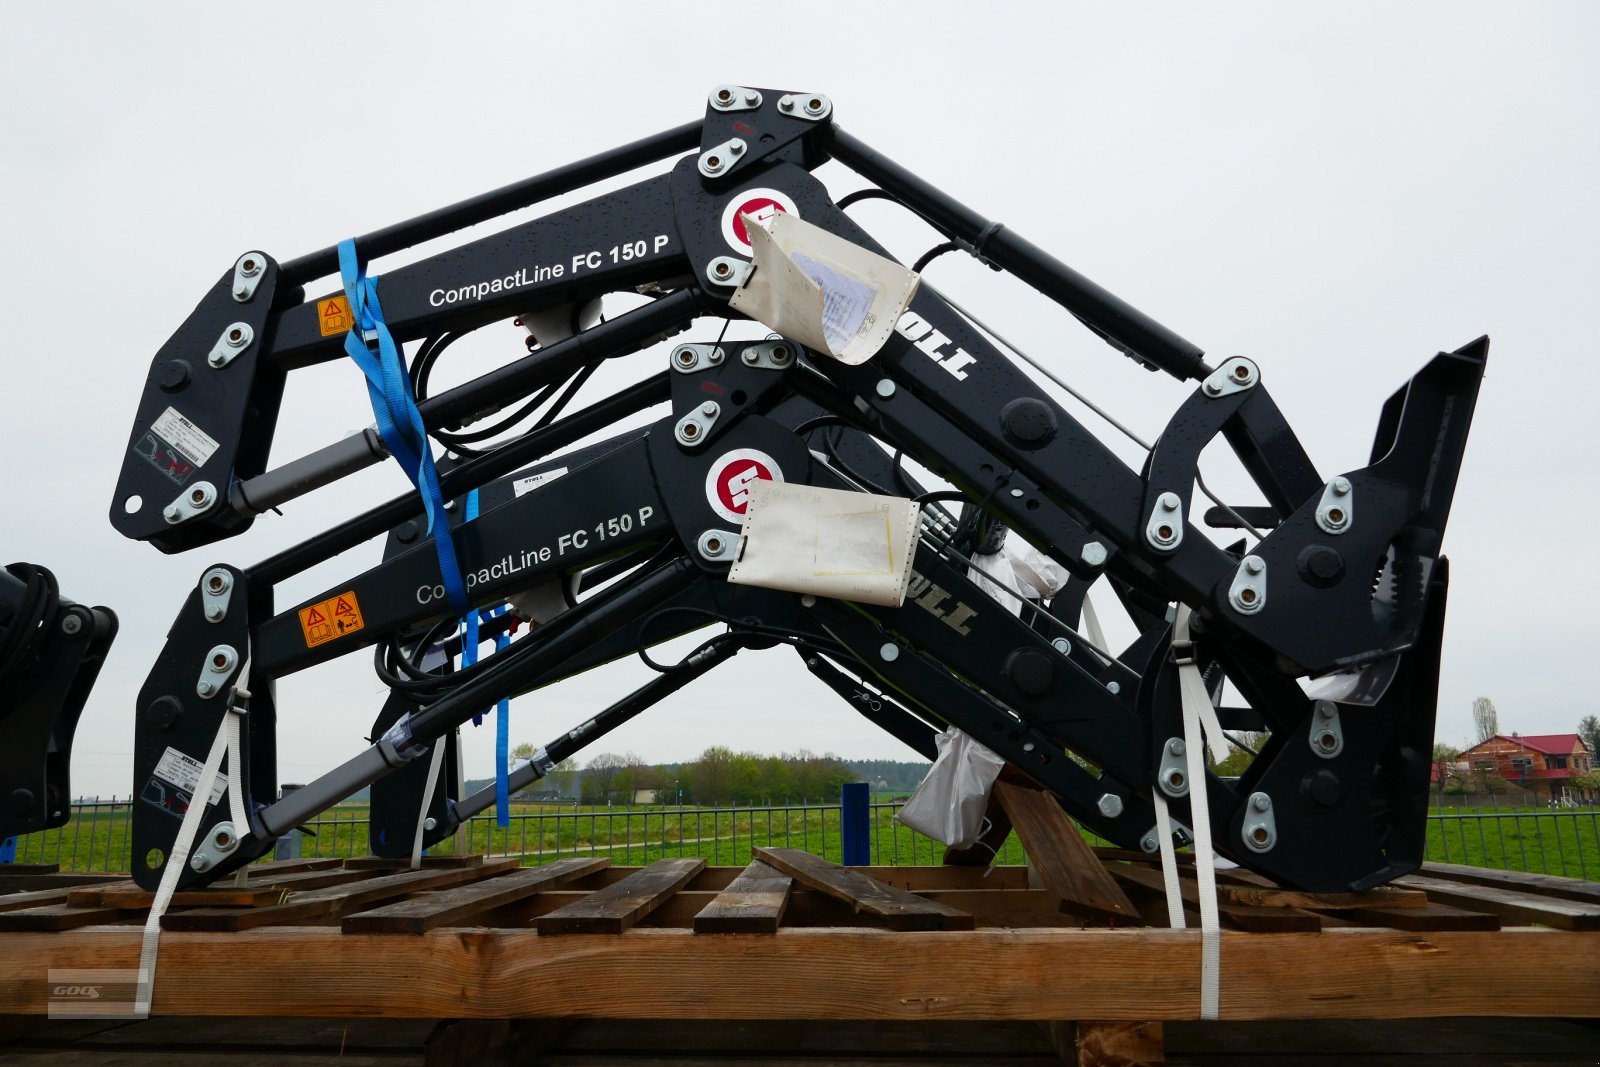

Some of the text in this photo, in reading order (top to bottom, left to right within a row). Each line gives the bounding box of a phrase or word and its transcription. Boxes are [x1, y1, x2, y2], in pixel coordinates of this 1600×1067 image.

[430, 235, 669, 307] CompactLine FC 150 P
[894, 307, 977, 381] OLL
[416, 506, 654, 605] CopactLine FC 150 P
